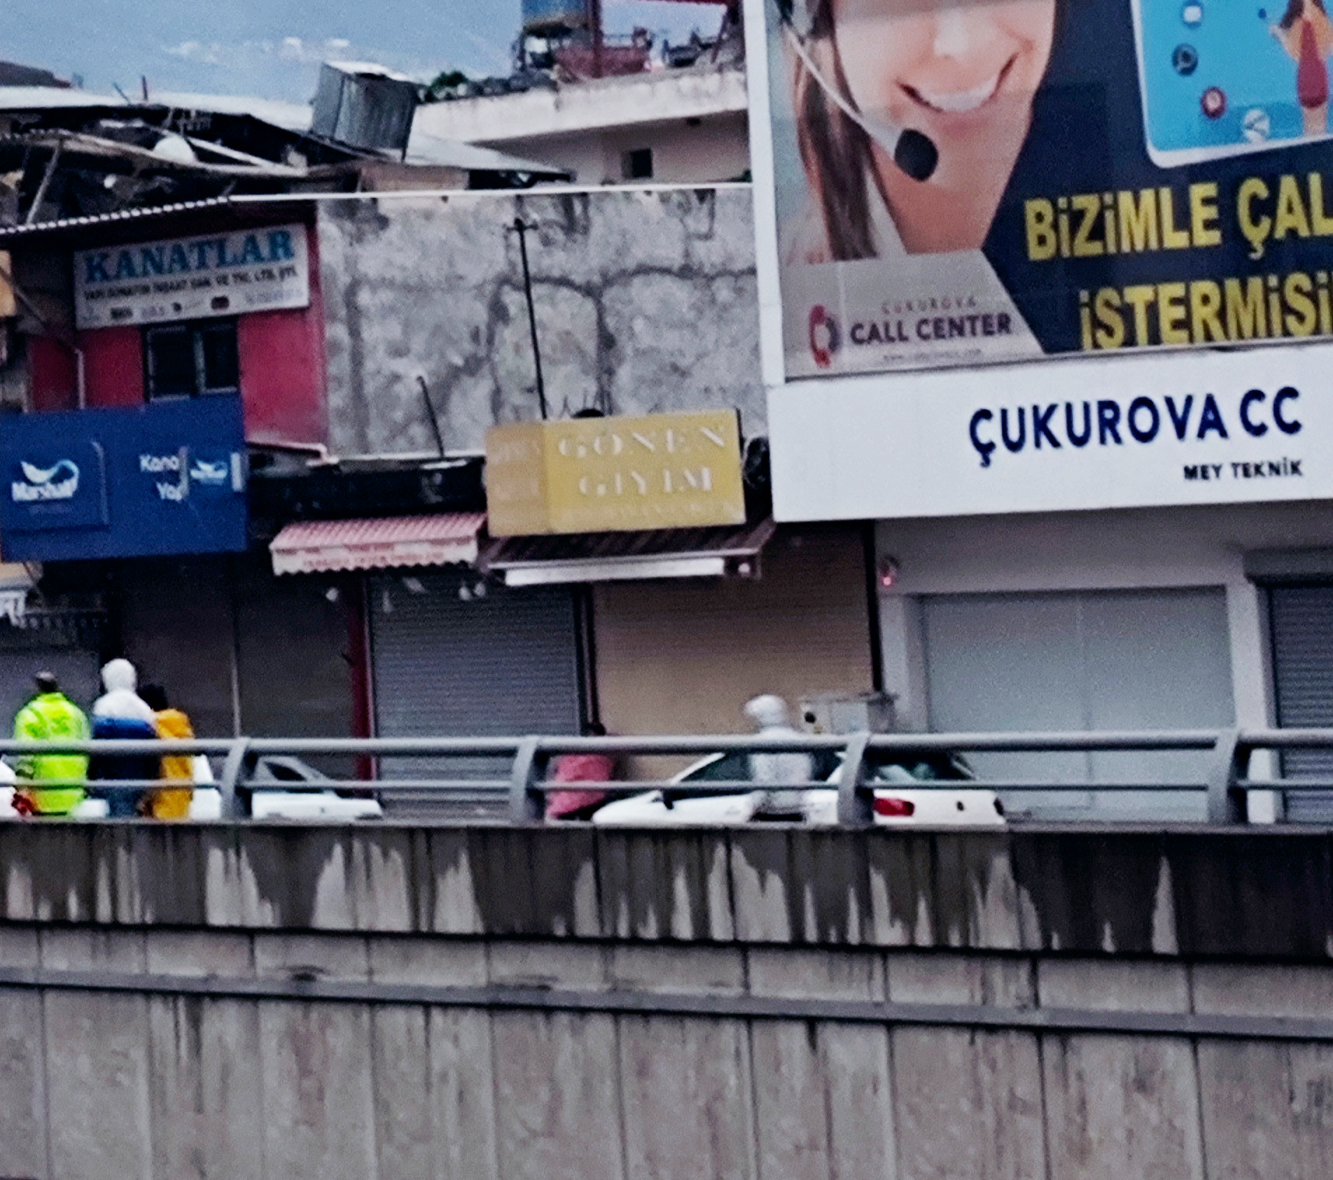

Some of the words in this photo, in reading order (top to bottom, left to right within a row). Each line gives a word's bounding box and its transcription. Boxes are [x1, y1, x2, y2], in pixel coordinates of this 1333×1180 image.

[84, 230, 296, 284] KANATLAR
[850, 320, 910, 347] CALL
[916, 312, 1012, 340] CENTER
[968, 392, 1230, 469] ÇUKUROVA
[1238, 386, 1303, 437] CC
[1183, 463, 1224, 481] MEY
[1231, 456, 1305, 480] TEKNİK
